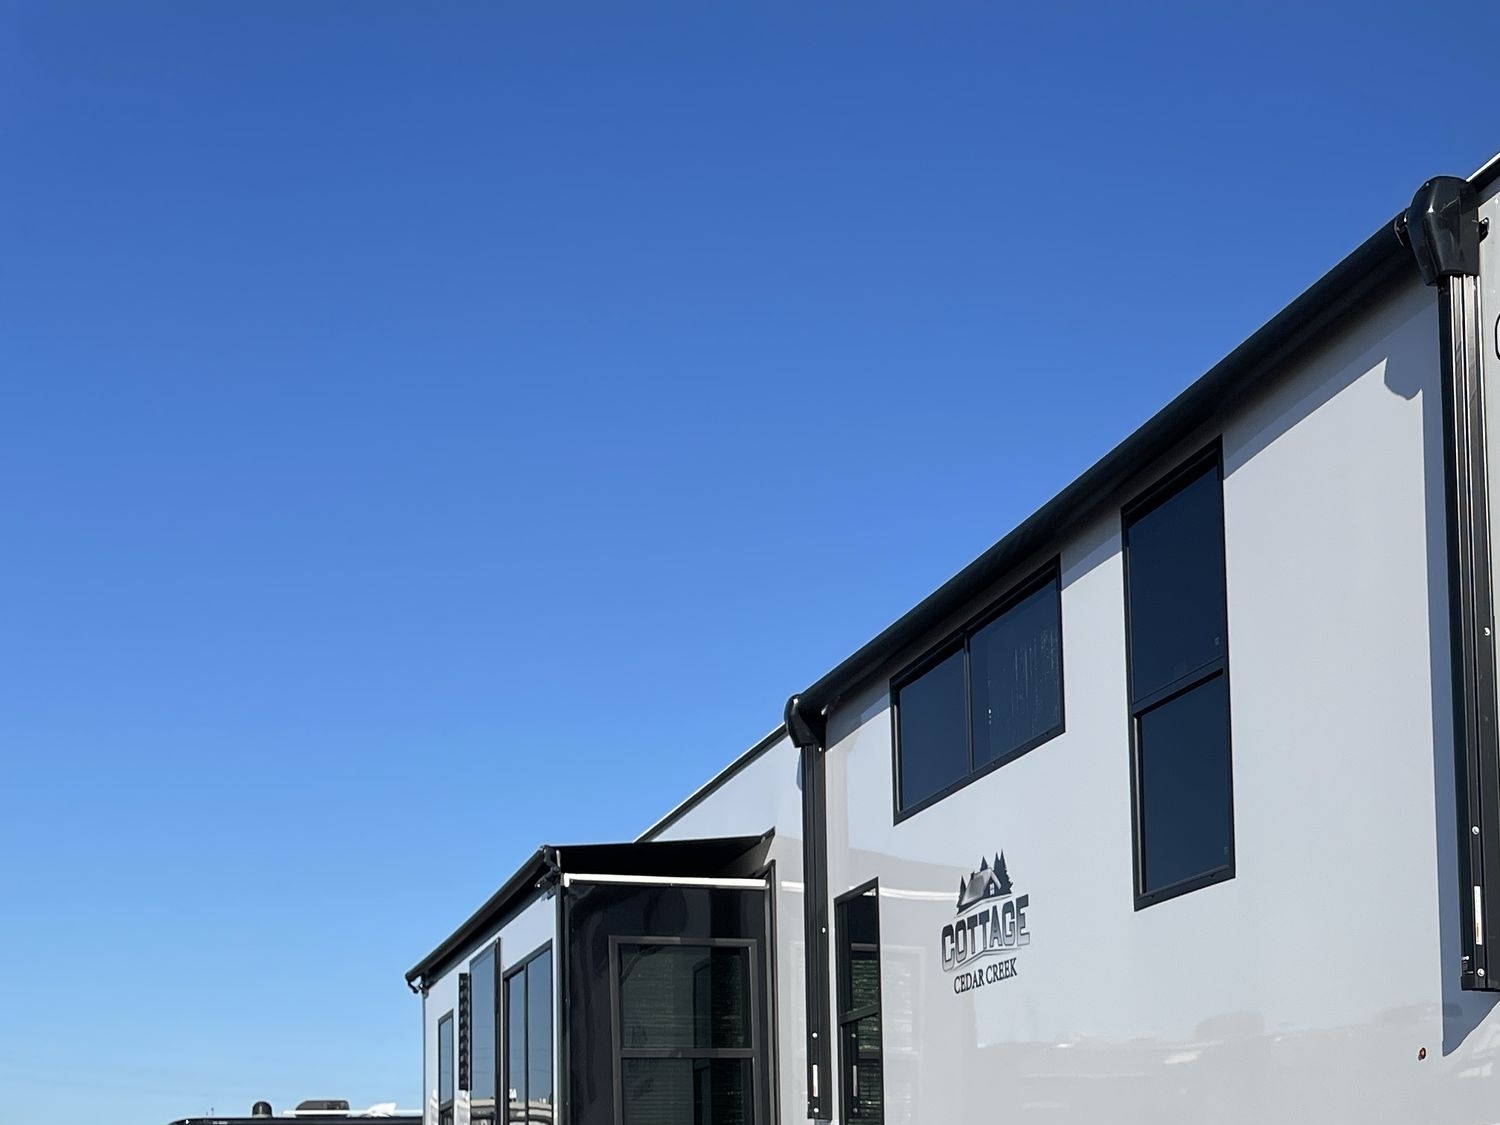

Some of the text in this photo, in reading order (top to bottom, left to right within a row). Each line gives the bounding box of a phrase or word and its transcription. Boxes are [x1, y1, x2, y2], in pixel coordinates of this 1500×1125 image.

[941, 894, 1030, 973] COTTAGE
[953, 957, 1018, 994] CEDAR CREEK
